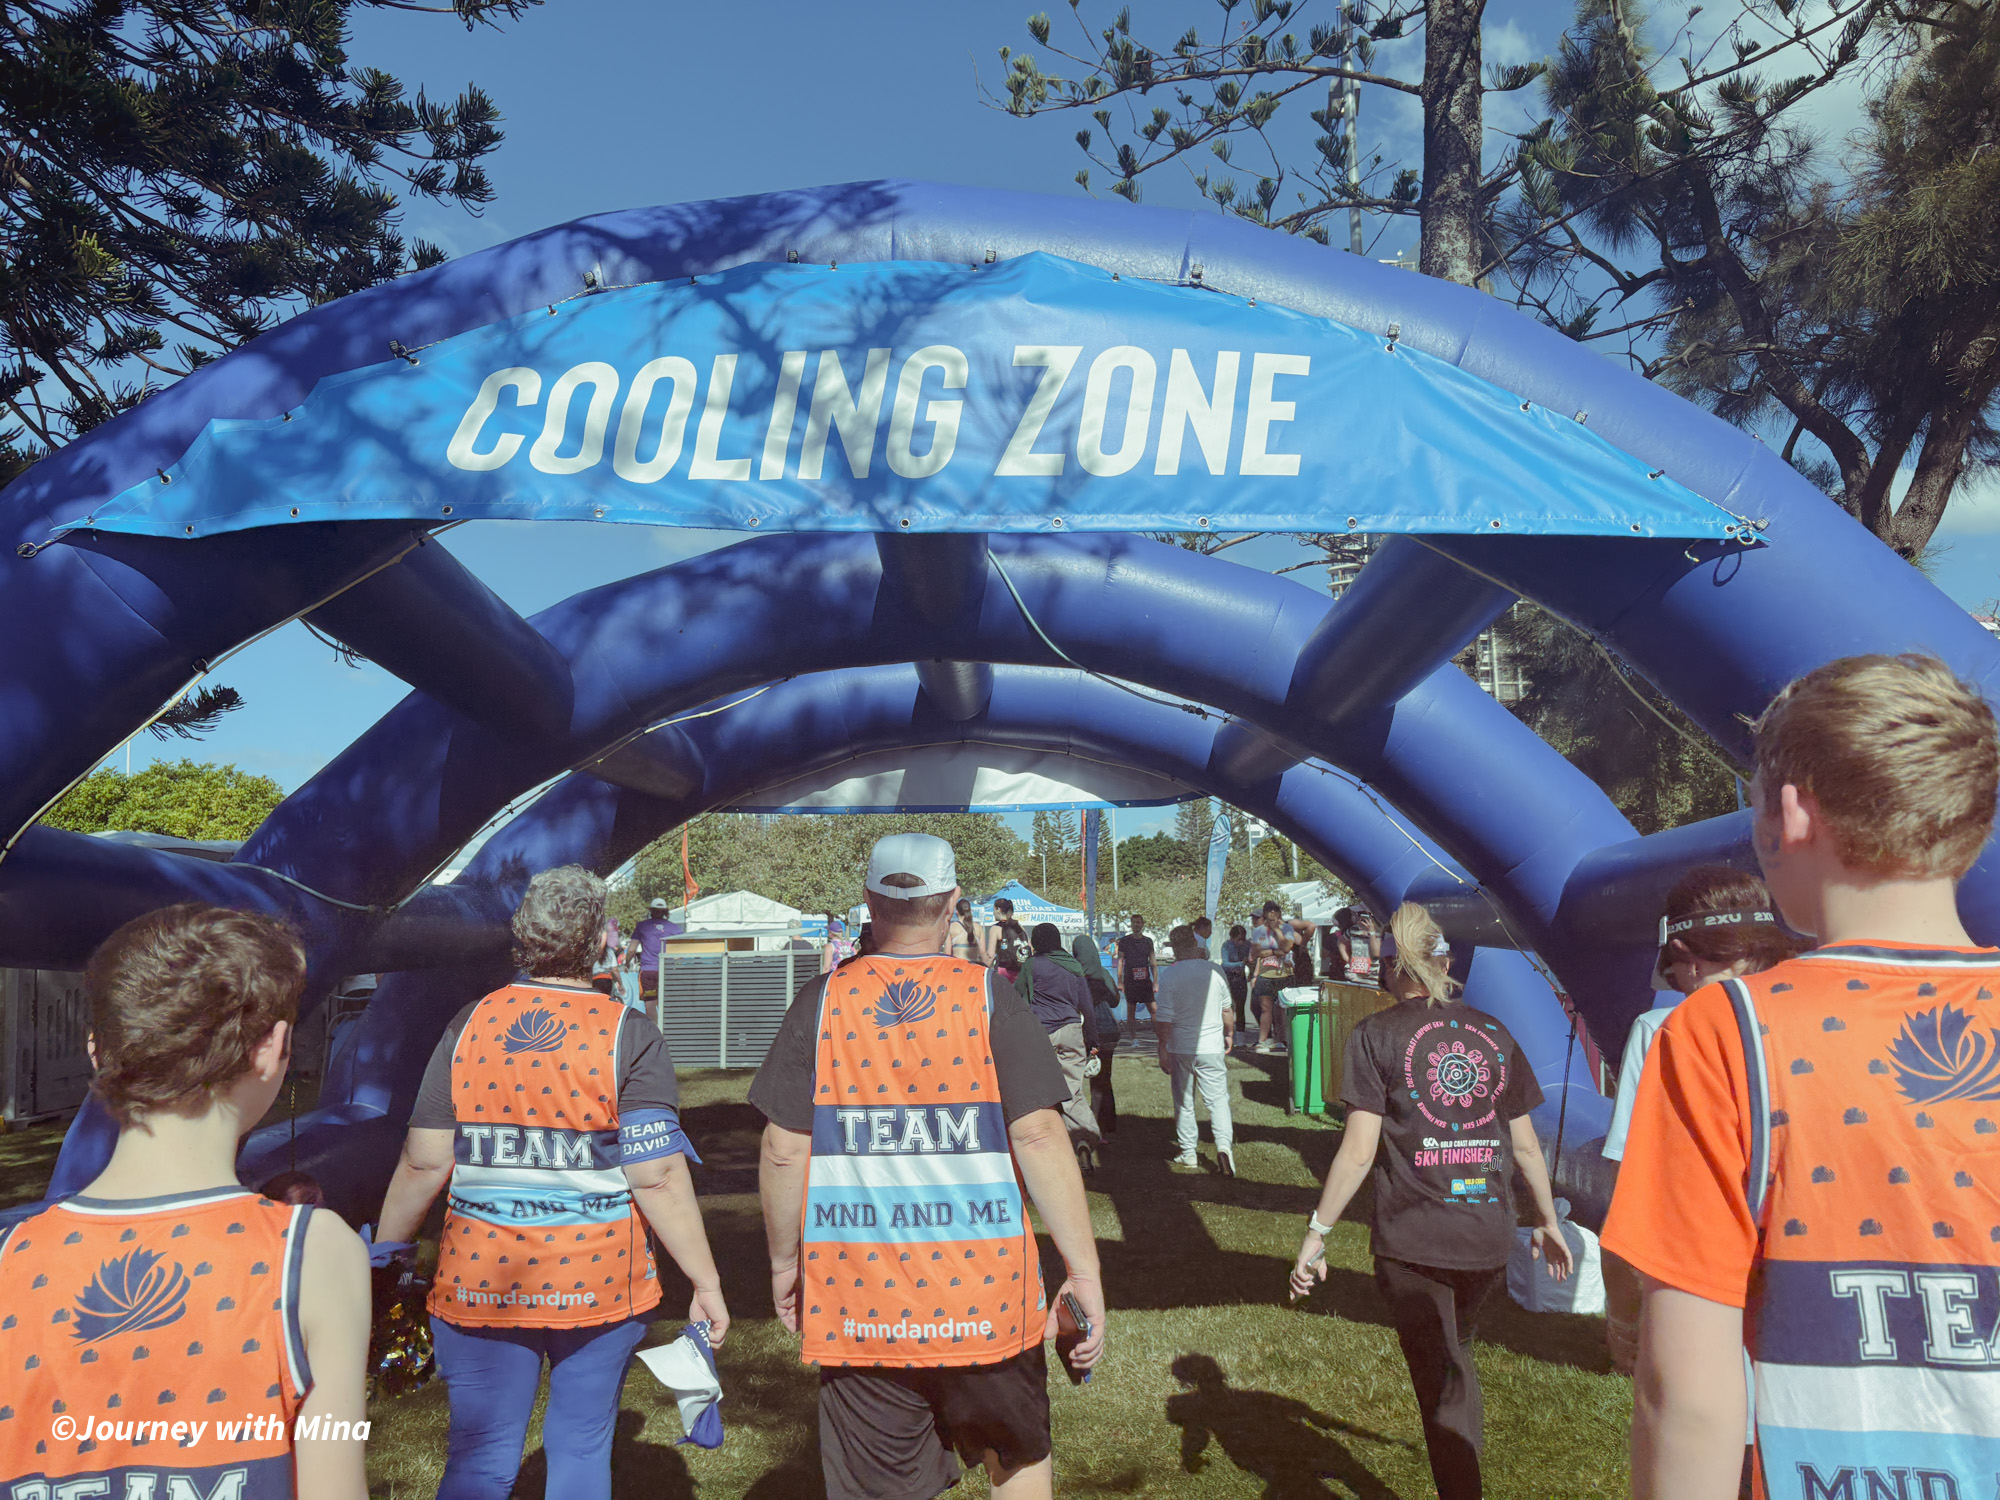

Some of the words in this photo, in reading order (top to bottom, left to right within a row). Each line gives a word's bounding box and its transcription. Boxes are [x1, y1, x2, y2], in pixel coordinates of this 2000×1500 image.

[446, 344, 969, 483] COOLING
[994, 345, 1312, 478] ZONE
[1031, 913, 1064, 922] MARATHON
[1667, 919, 1693, 934] 2XU
[1704, 912, 1742, 926] 2XU
[1406, 1037, 1418, 1057] COAST
[1414, 1023, 1433, 1041] AIRPORT
[1432, 1020, 1445, 1029] 5KM
[622, 1120, 667, 1138] TEAM
[836, 1106, 981, 1153] TEAM
[462, 1125, 593, 1169] TEAM
[622, 1135, 671, 1156] DAVID
[1453, 1140, 1468, 1148] COAST
[1468, 1139, 1490, 1147] AIRPORT
[1414, 1150, 1439, 1167] 5KM
[1442, 1147, 1494, 1165] FINISHER
[814, 1203, 877, 1228] MND
[889, 1202, 954, 1228] AND
[968, 1198, 1011, 1225] ME
[456, 1286, 596, 1306] #mndandme
[1829, 1269, 2000, 1365] TE
[843, 1318, 993, 1340] #mndandme
